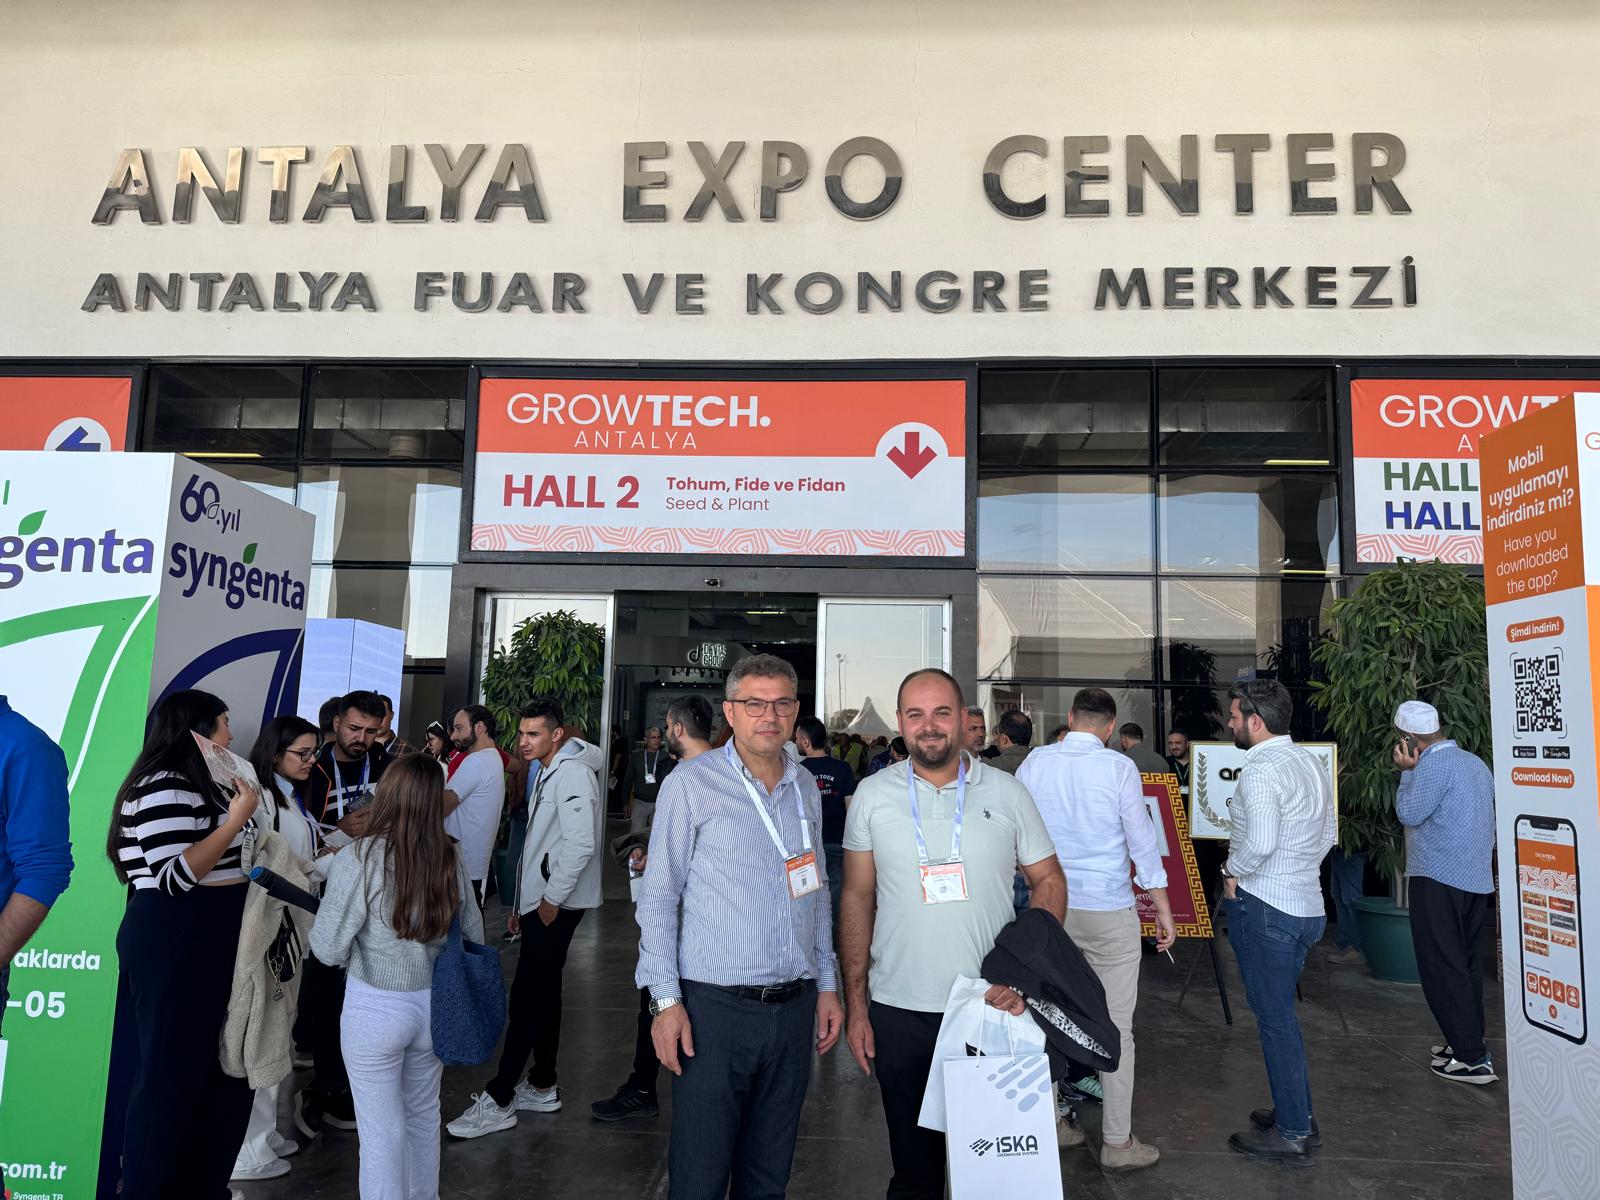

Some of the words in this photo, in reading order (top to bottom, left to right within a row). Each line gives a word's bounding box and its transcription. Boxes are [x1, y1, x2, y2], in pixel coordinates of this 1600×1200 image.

[91, 143, 547, 225] ANTALYA
[623, 135, 903, 222] EXPO
[983, 132, 1412, 220] CENTER
[80, 271, 377, 313] ANTALYA
[414, 271, 586, 313] FUAR
[622, 272, 705, 314] VE
[746, 269, 1048, 314] KONGRE
[1095, 255, 1417, 310] MERKEZİ
[573, 430, 697, 449] ANTALYA
[1507, 444, 1544, 474] Mobil
[503, 474, 606, 508] HALL
[616, 475, 640, 508] 2
[666, 476, 731, 494] Tohum,
[735, 477, 770, 492] Fide
[774, 480, 794, 492] ve
[798, 477, 846, 492] Fidan
[1383, 462, 1479, 491] HALL
[1489, 465, 1568, 509] uygulamayı
[666, 497, 706, 511] Seed
[711, 498, 723, 511] &
[728, 498, 769, 511] Plant
[1385, 501, 1481, 530] HALL
[1486, 500, 1545, 532] indirdiniz
[1548, 488, 1575, 512] mi?
[1504, 536, 1532, 553] Have
[1535, 527, 1557, 549] you
[1496, 543, 1568, 576] downloaded
[168, 541, 306, 610] syngenta
[1506, 579, 1525, 594] the
[1528, 569, 1558, 592] app?
[1513, 771, 1550, 783] Download
[1551, 773, 1573, 784] Now!
[13, 948, 101, 970] aklarda
